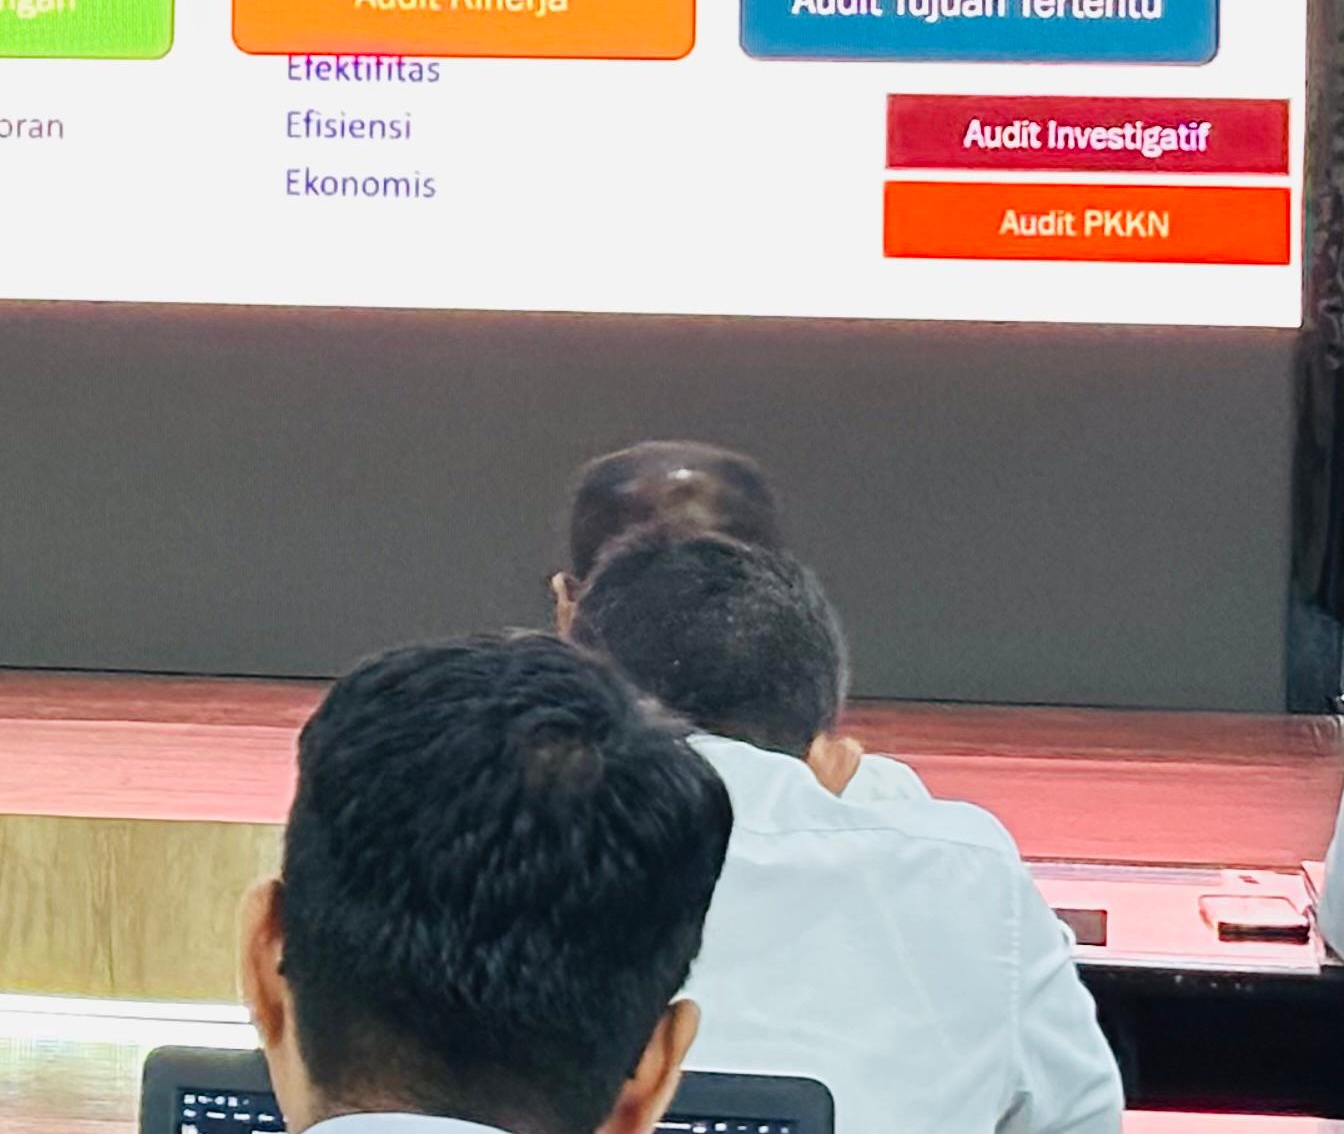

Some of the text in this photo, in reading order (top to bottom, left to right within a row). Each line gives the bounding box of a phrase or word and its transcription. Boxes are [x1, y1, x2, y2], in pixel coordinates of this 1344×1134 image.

[286, 111, 412, 139] Efisiensi
[963, 120, 1212, 157] Audit Investigatif
[286, 169, 437, 198] Ekonomis
[999, 210, 1170, 238] Audit PKKN
